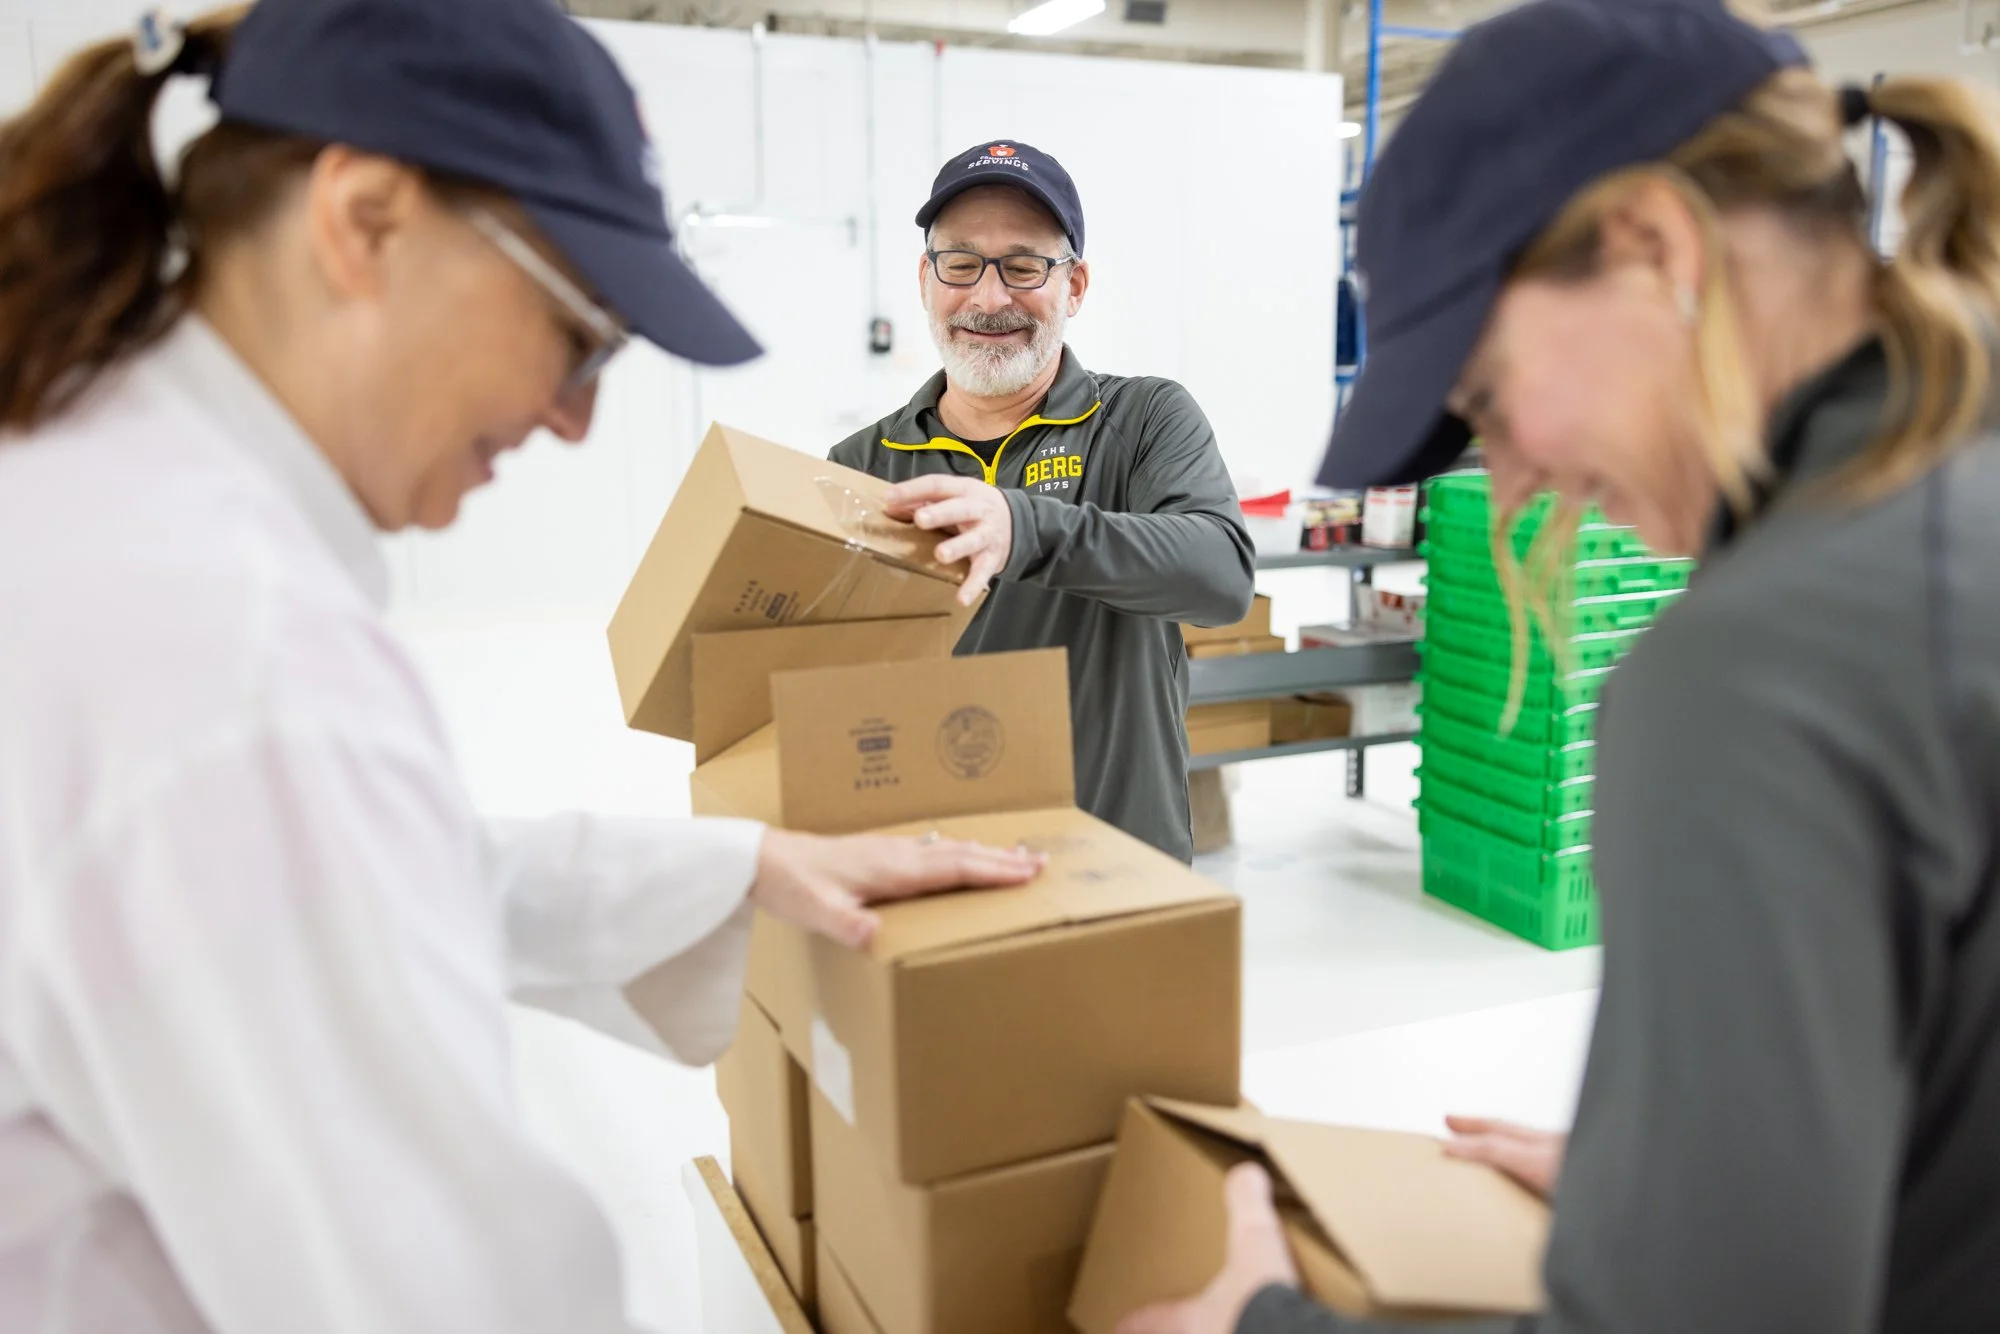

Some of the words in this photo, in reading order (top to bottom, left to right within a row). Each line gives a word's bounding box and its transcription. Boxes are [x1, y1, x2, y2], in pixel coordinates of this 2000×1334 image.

[967, 159, 1029, 171] SERVINGS
[1041, 446, 1066, 456] THE
[1025, 455, 1082, 487] BERG
[1039, 481, 1069, 493] 1975
